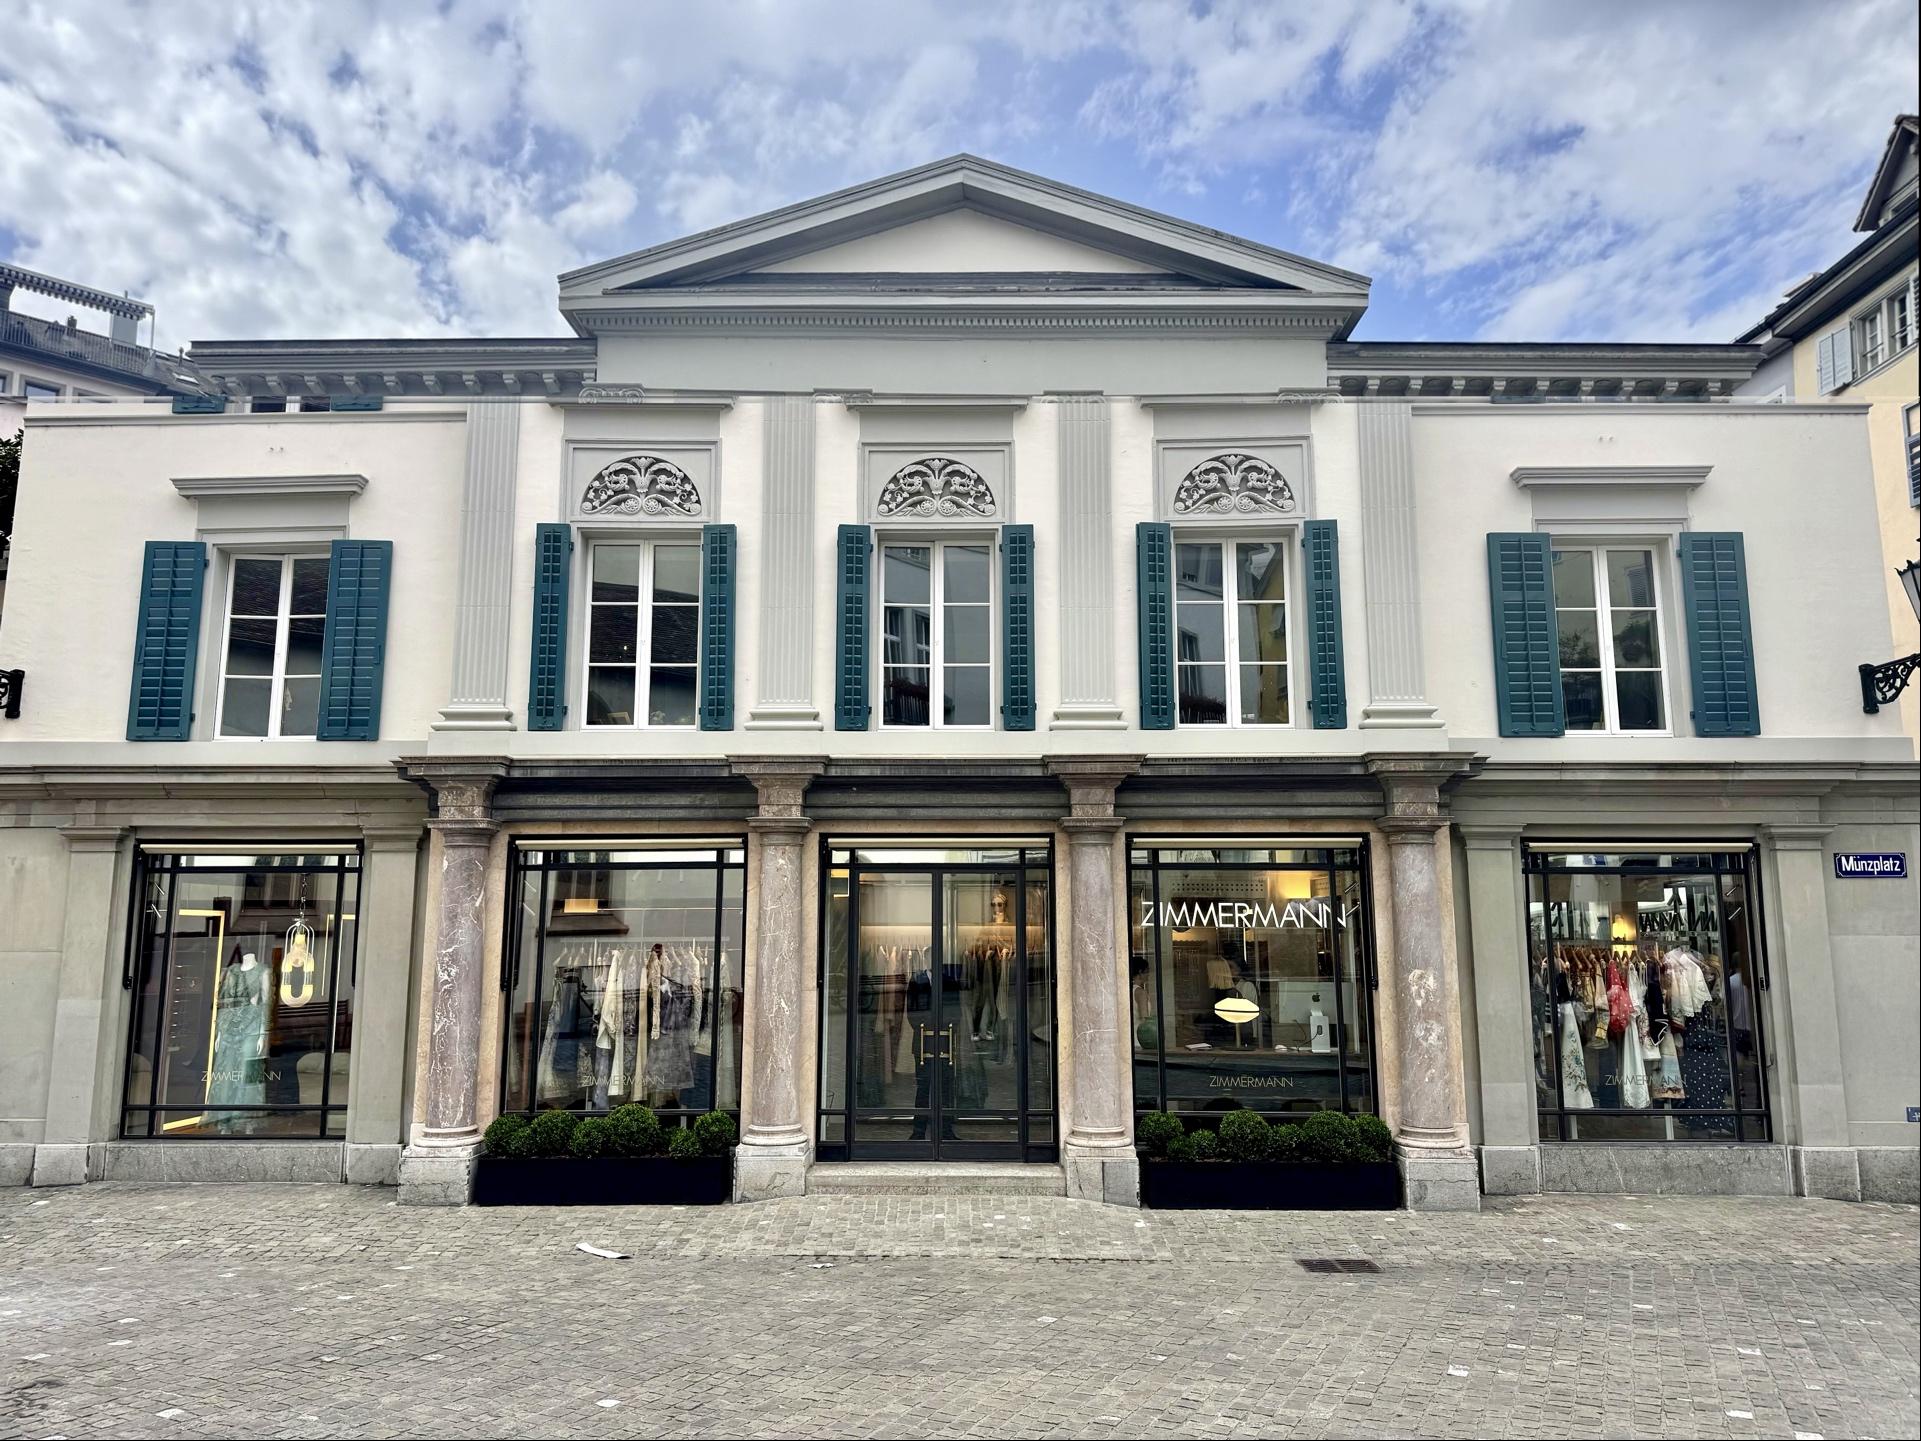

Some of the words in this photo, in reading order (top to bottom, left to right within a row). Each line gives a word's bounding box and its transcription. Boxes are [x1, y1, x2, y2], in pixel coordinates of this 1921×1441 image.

[1841, 855, 1901, 875] Münzplatz
[1141, 901, 1347, 928] ZIMMERMANN
[201, 1070, 282, 1082] ZMMERMNN
[1209, 1075, 1294, 1088] ZIMMERMANN
